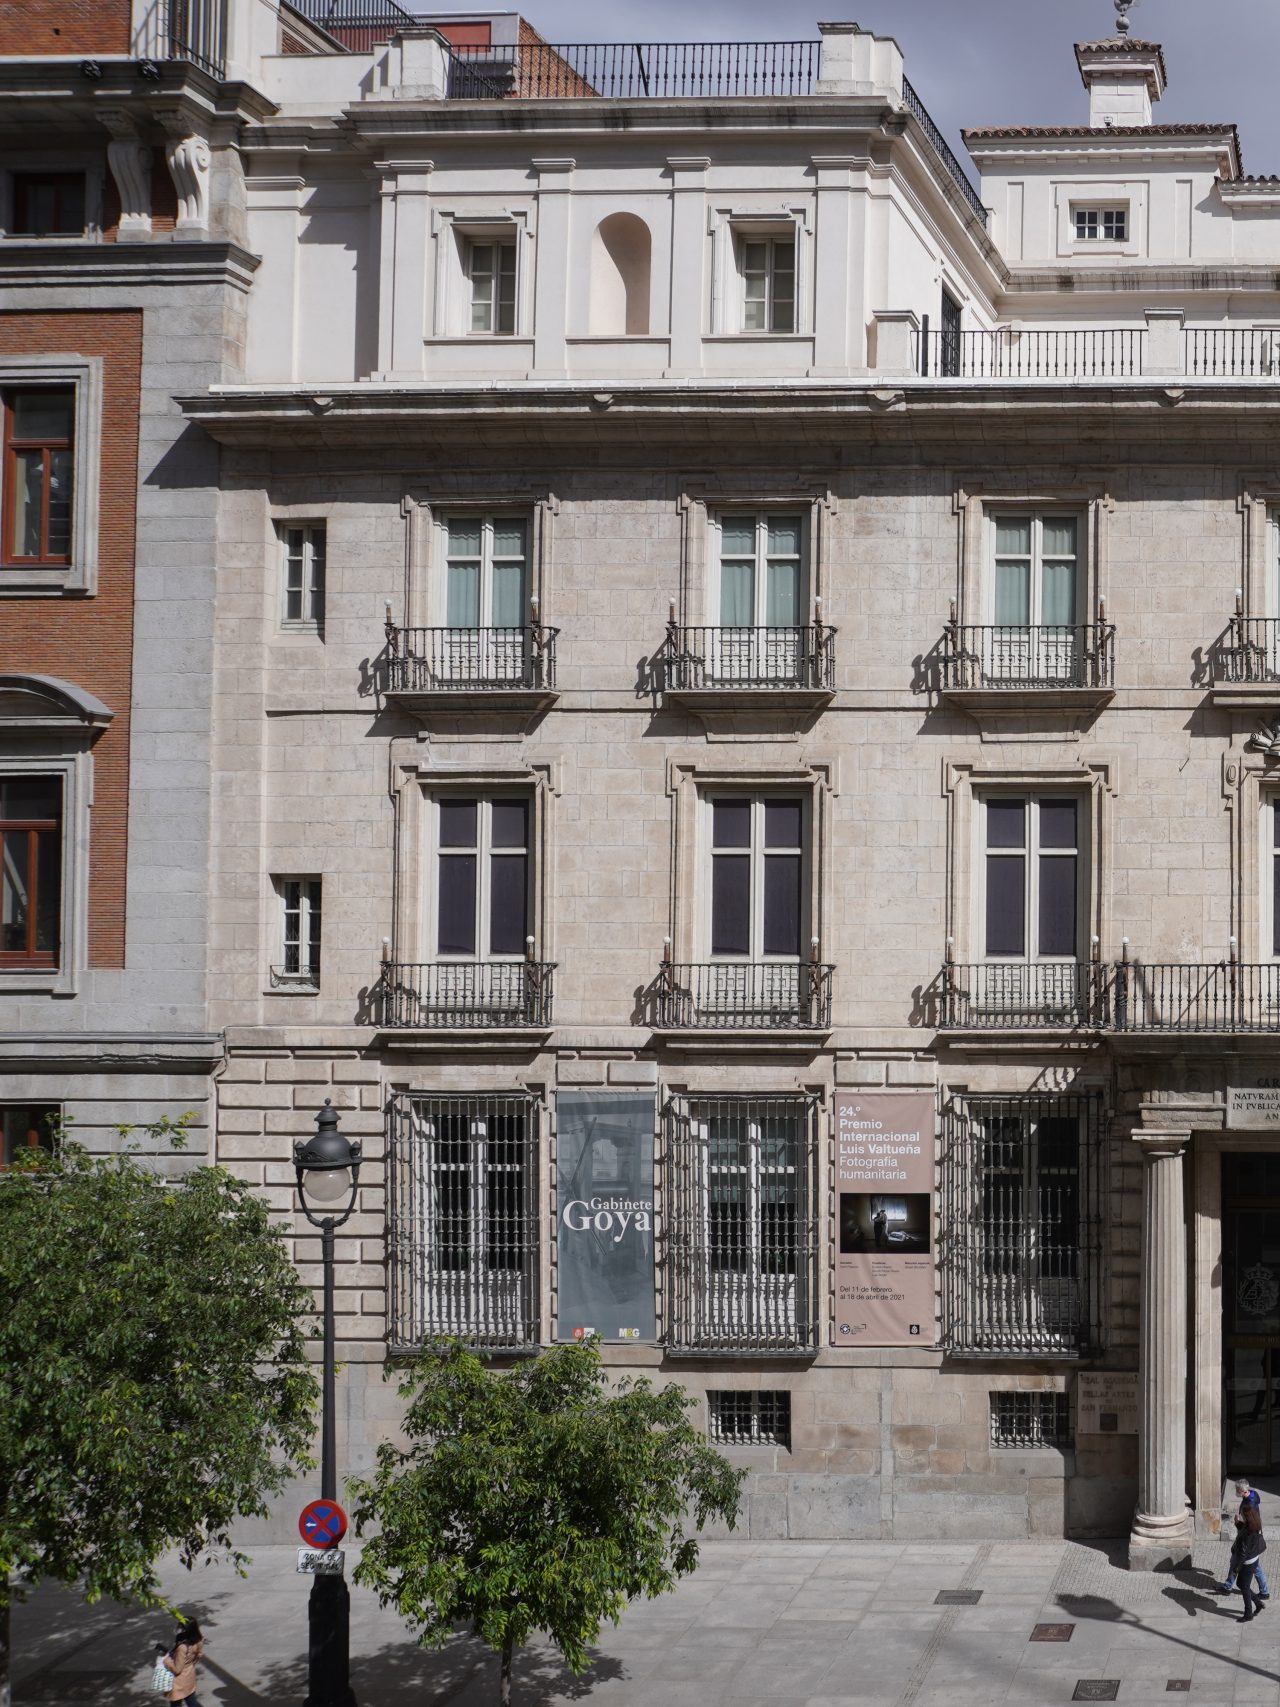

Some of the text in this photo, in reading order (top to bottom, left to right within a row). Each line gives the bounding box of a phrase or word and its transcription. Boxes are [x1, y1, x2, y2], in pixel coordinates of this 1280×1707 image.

[839, 1119, 883, 1129] Premio
[839, 1131, 920, 1142] Internacional
[839, 1143, 921, 1154] Luis Valtueña
[839, 1156, 898, 1169] Fotografía
[839, 1168, 907, 1180] humanitaria
[590, 1197, 653, 1210] Gabinete
[562, 1200, 652, 1243] Goya
[839, 1285, 851, 1293] Del
